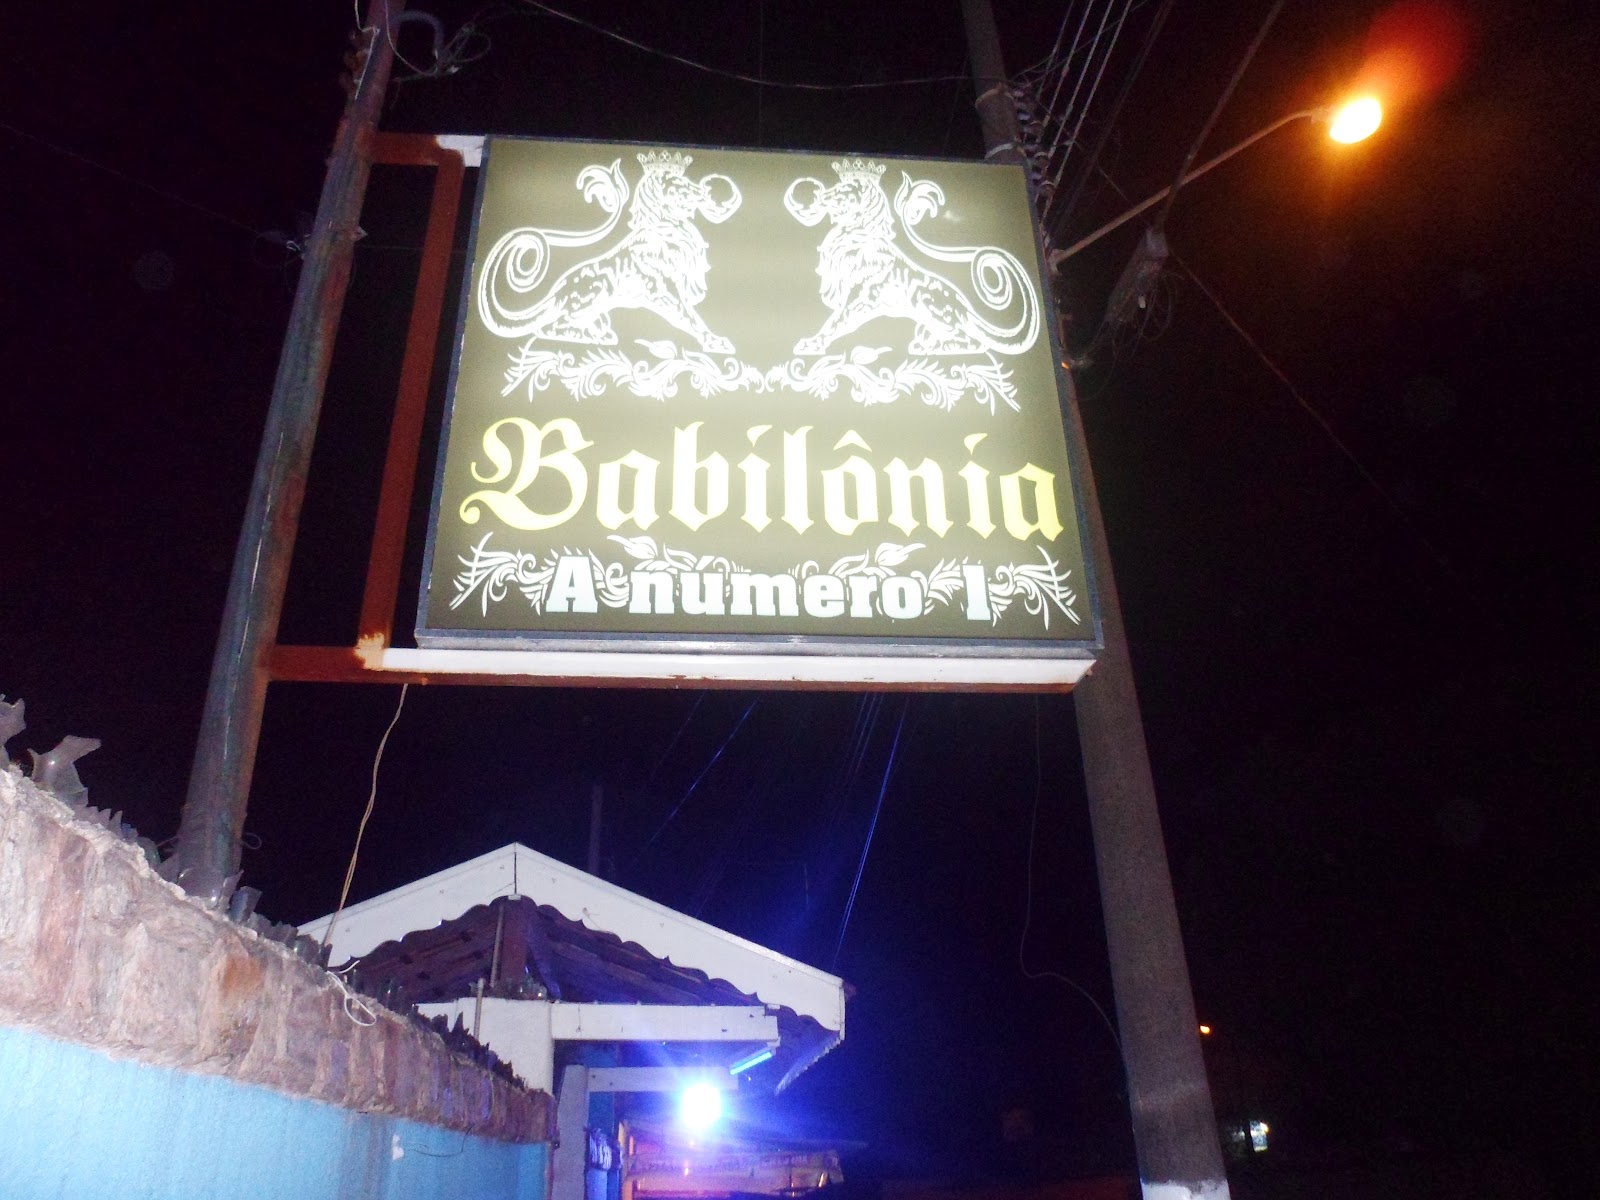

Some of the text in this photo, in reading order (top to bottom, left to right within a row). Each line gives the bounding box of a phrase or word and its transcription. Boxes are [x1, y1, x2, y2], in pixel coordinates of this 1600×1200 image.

[459, 416, 1064, 541] Babilônia
[545, 555, 599, 614] A
[963, 564, 991, 621] 1
